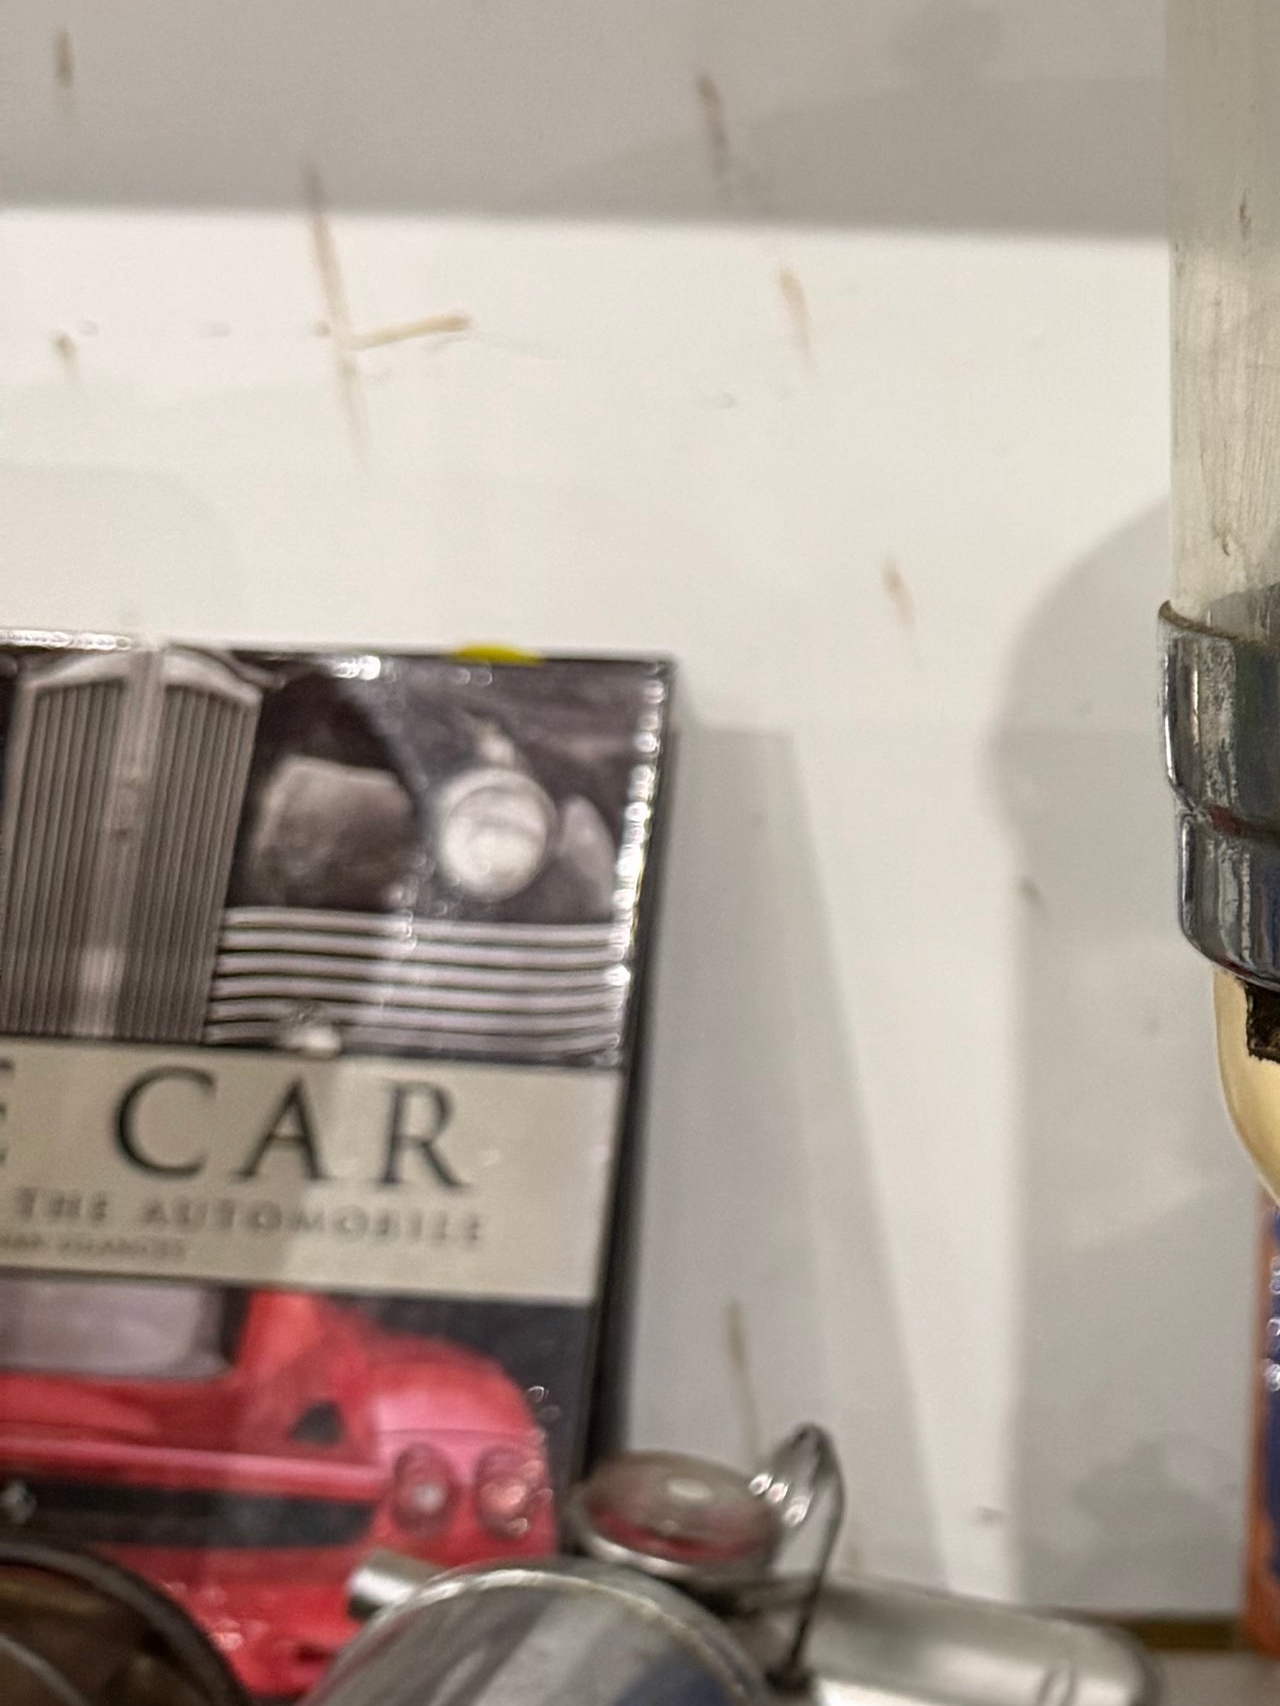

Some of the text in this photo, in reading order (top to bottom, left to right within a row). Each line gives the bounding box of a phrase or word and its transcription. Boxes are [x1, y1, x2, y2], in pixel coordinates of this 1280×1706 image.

[113, 1065, 468, 1189] CAR
[16, 1186, 484, 1246] THE AUTOMOBILE
